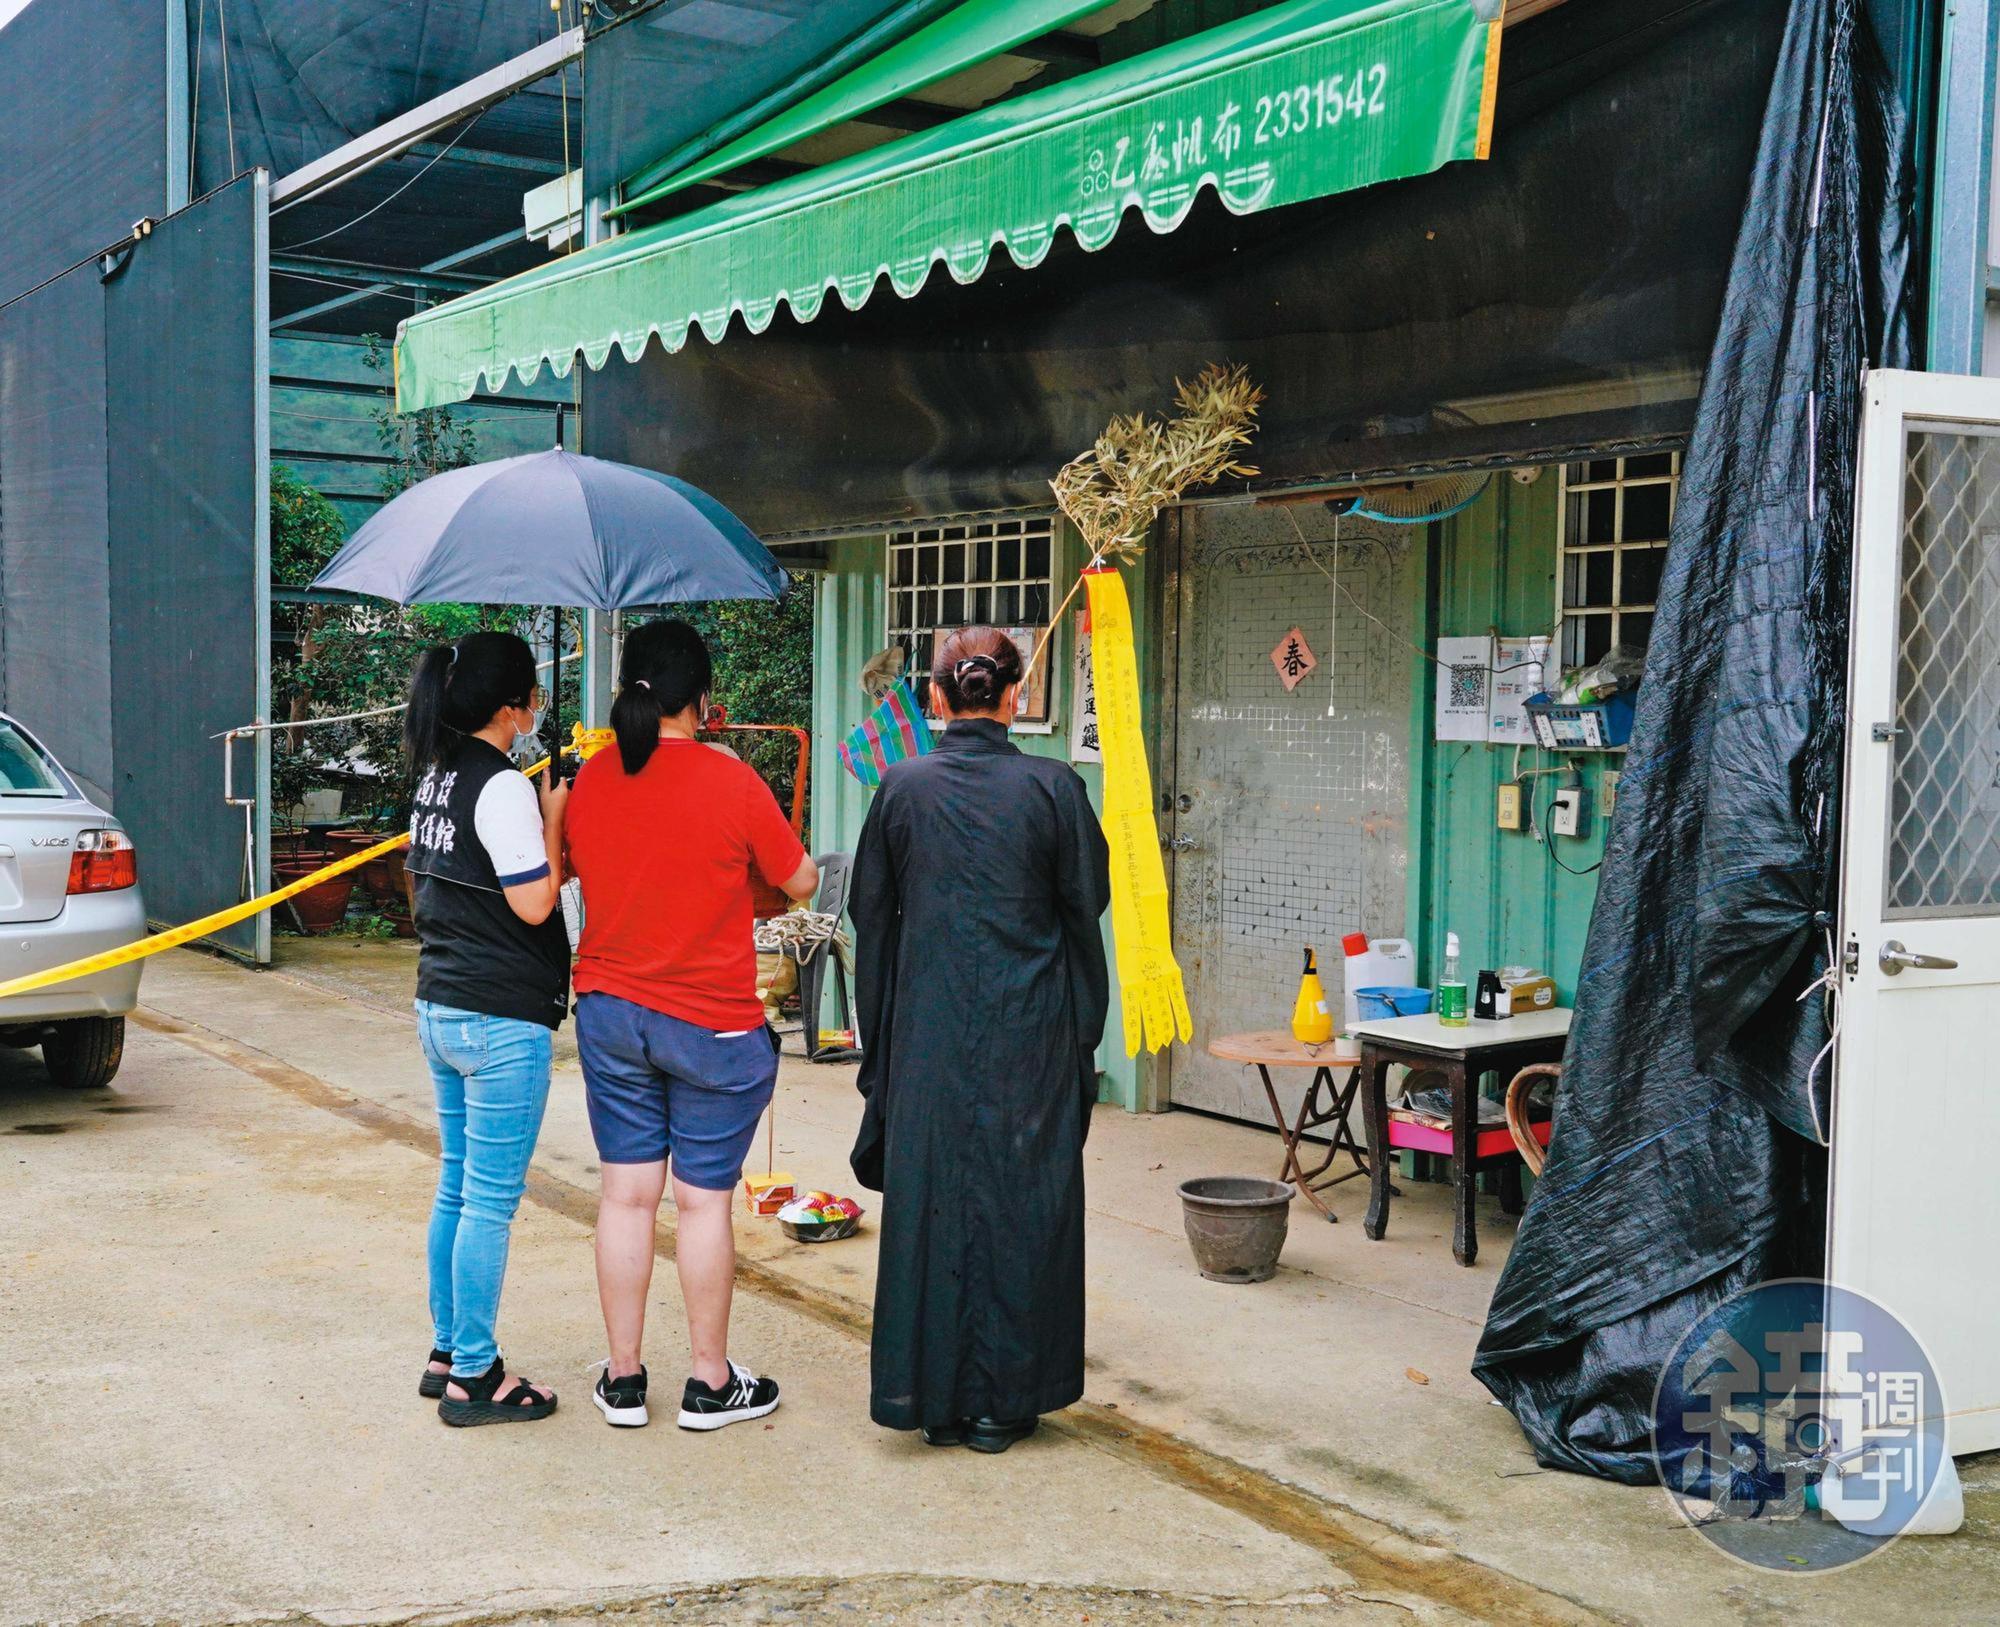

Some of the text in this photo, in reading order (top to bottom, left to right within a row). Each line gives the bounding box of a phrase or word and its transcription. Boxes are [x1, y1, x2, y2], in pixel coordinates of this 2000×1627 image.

[1254, 62, 1387, 144] 2331542
[1281, 638, 1309, 677] 春
[416, 766, 458, 809] 南投
[30, 837, 70, 847] VIOS
